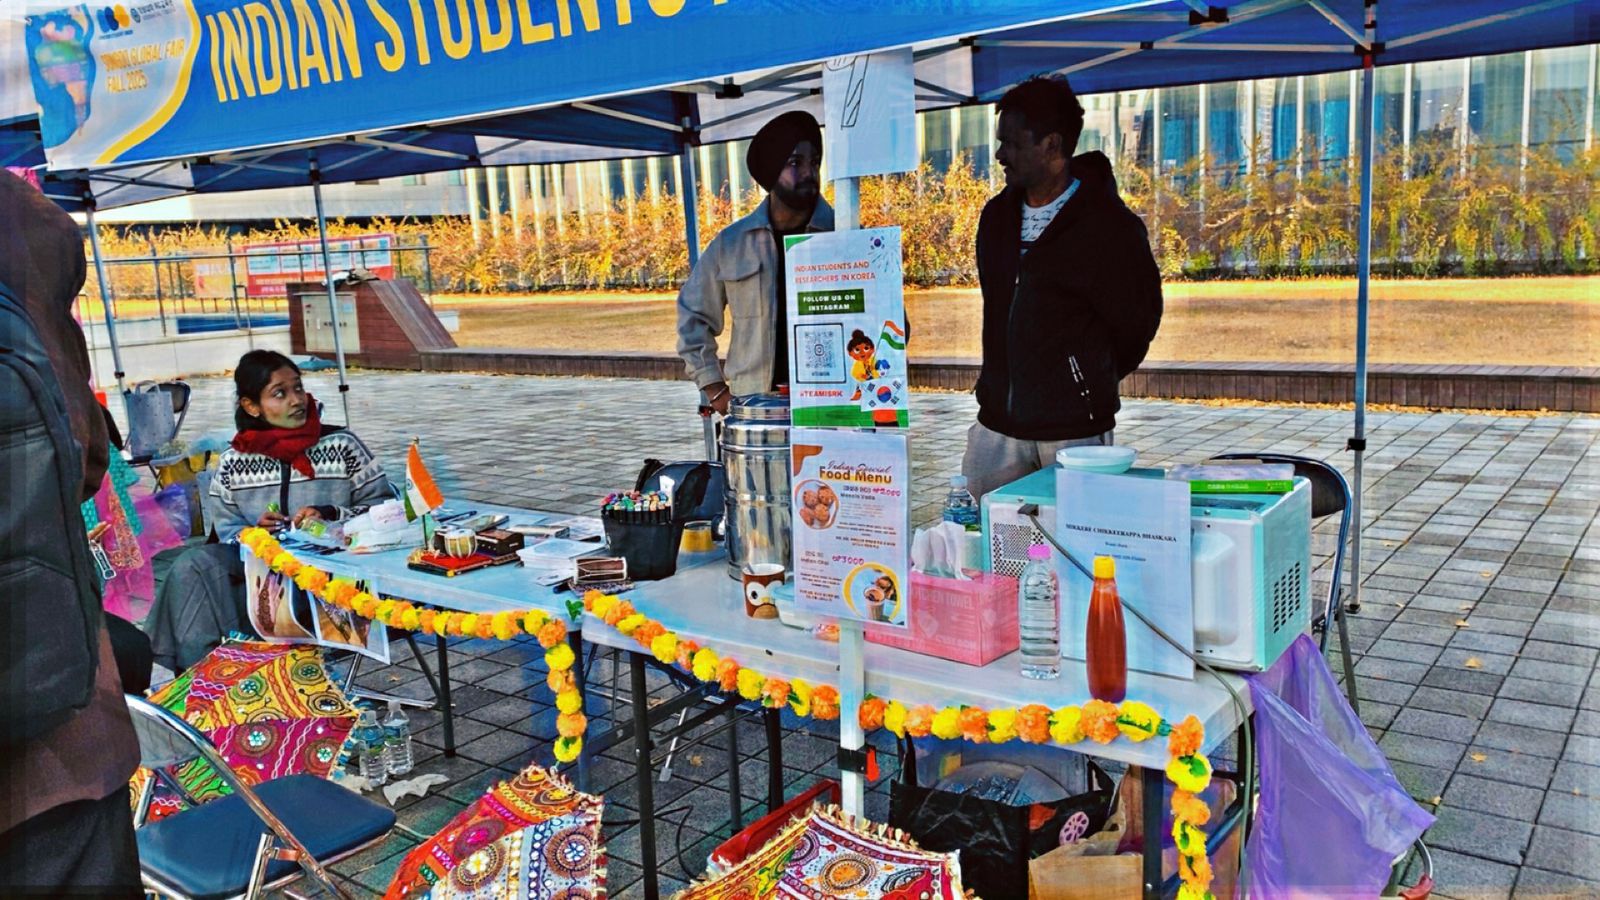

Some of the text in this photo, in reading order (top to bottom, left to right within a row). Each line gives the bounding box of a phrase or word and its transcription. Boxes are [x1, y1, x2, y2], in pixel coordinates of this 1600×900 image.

[130, 43, 162, 66] GLOBAL
[166, 38, 185, 58] FAIR
[206, 0, 687, 103] INDIAN STUDE
[106, 75, 125, 93] FALL
[795, 261, 870, 273] INDIAN STUDENTS AND
[795, 272, 876, 284] RESEARCHERS IN KOREA
[803, 295, 829, 303] FOLLOW
[808, 303, 850, 311] INSTAGRAM
[819, 465, 892, 484] Food Menu
